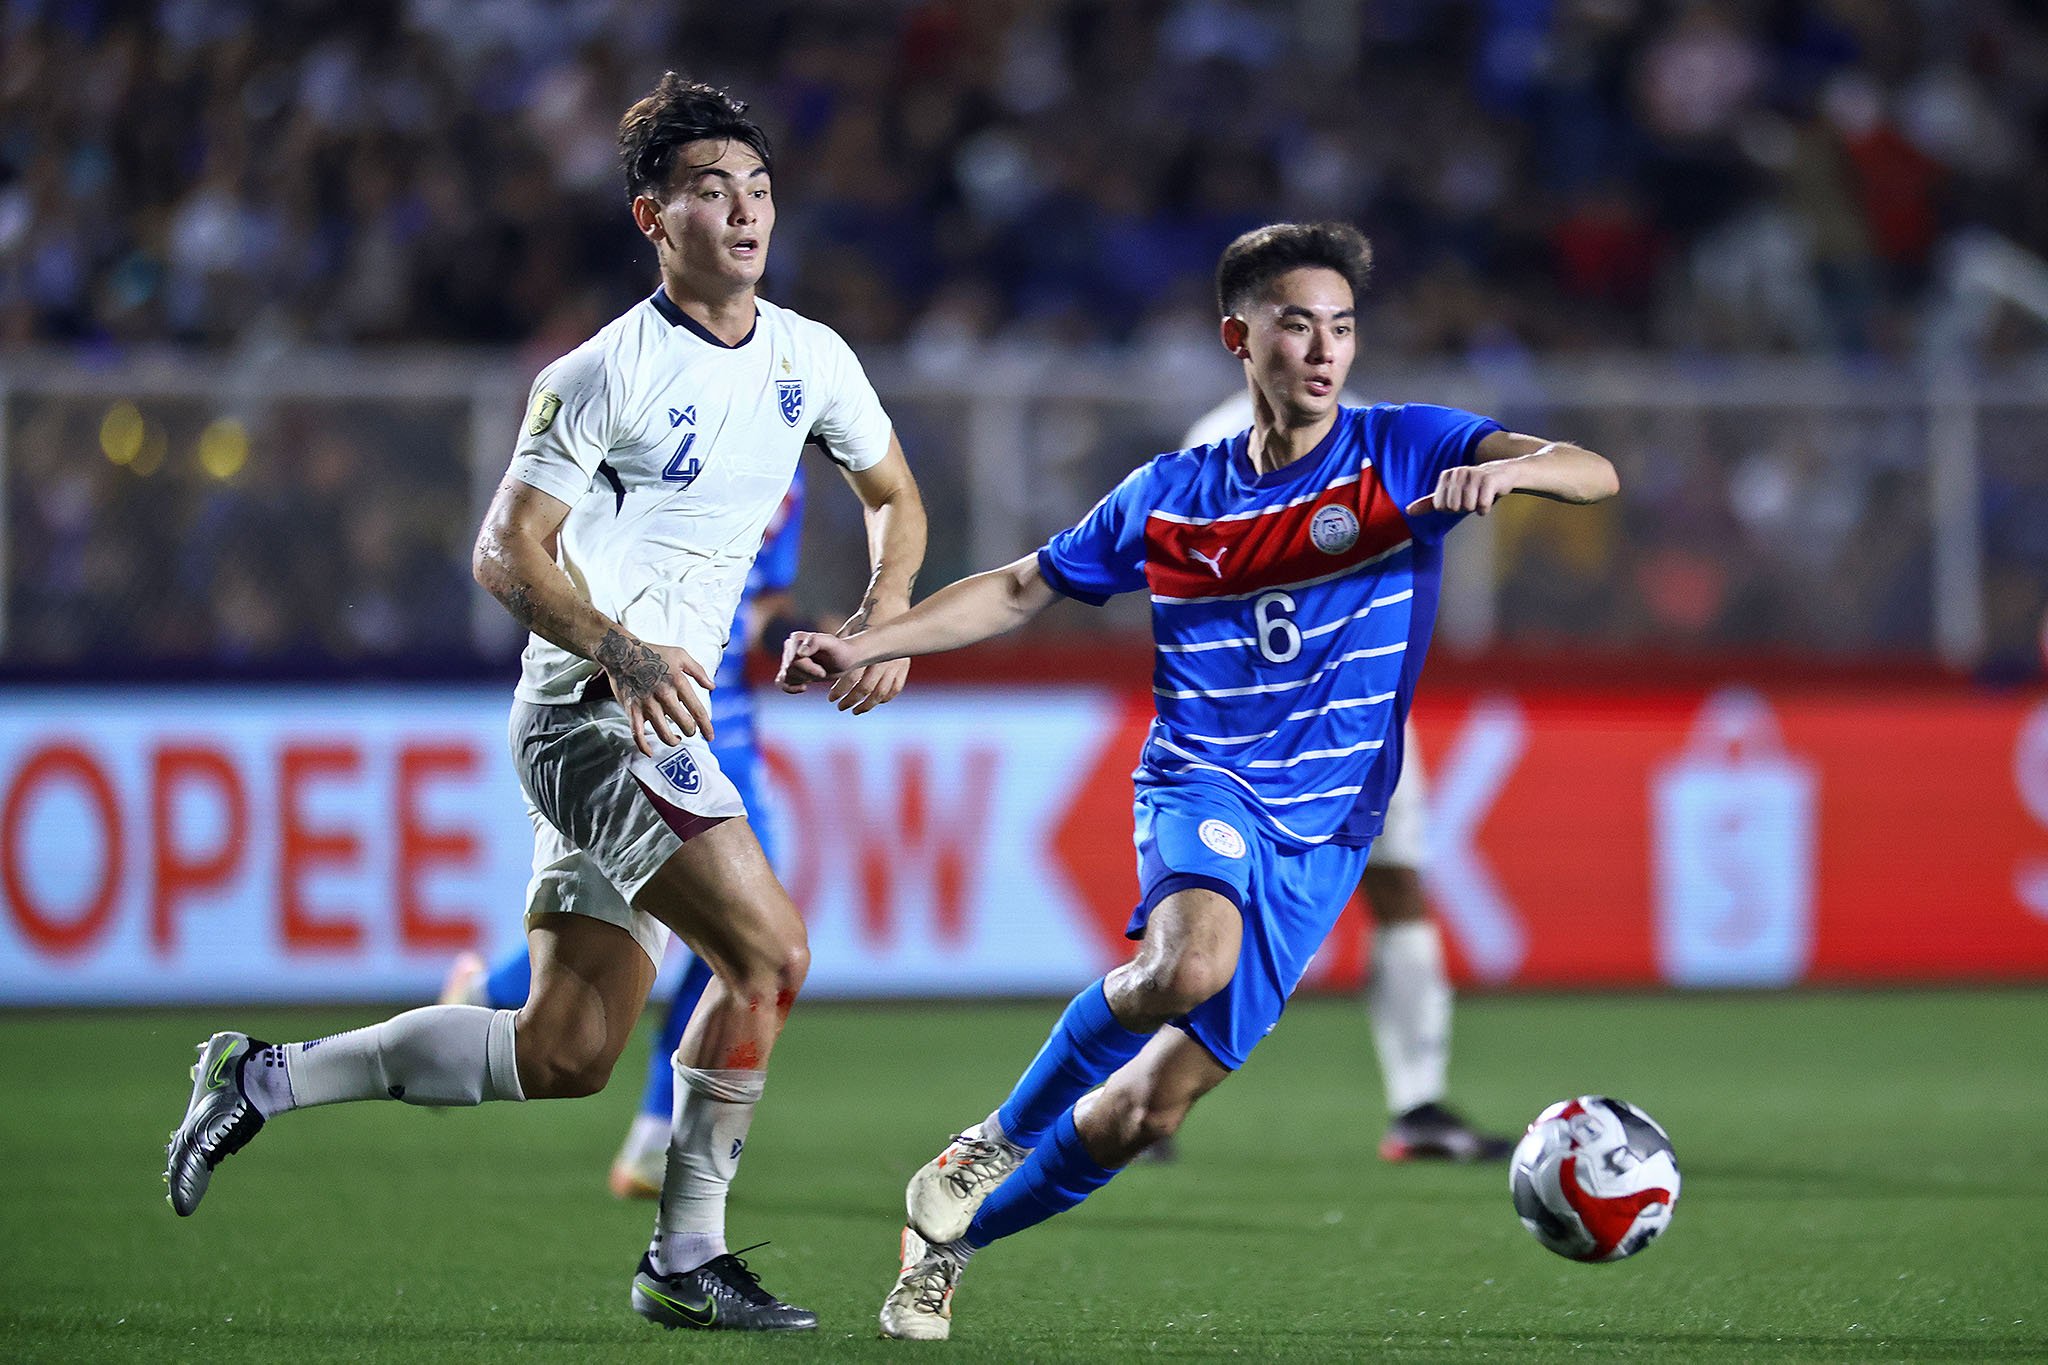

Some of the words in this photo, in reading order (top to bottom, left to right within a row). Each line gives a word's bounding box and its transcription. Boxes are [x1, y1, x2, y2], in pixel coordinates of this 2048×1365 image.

[661, 432, 700, 488] 4
[1254, 590, 1302, 663] 6
[2, 740, 488, 958] OPEE
